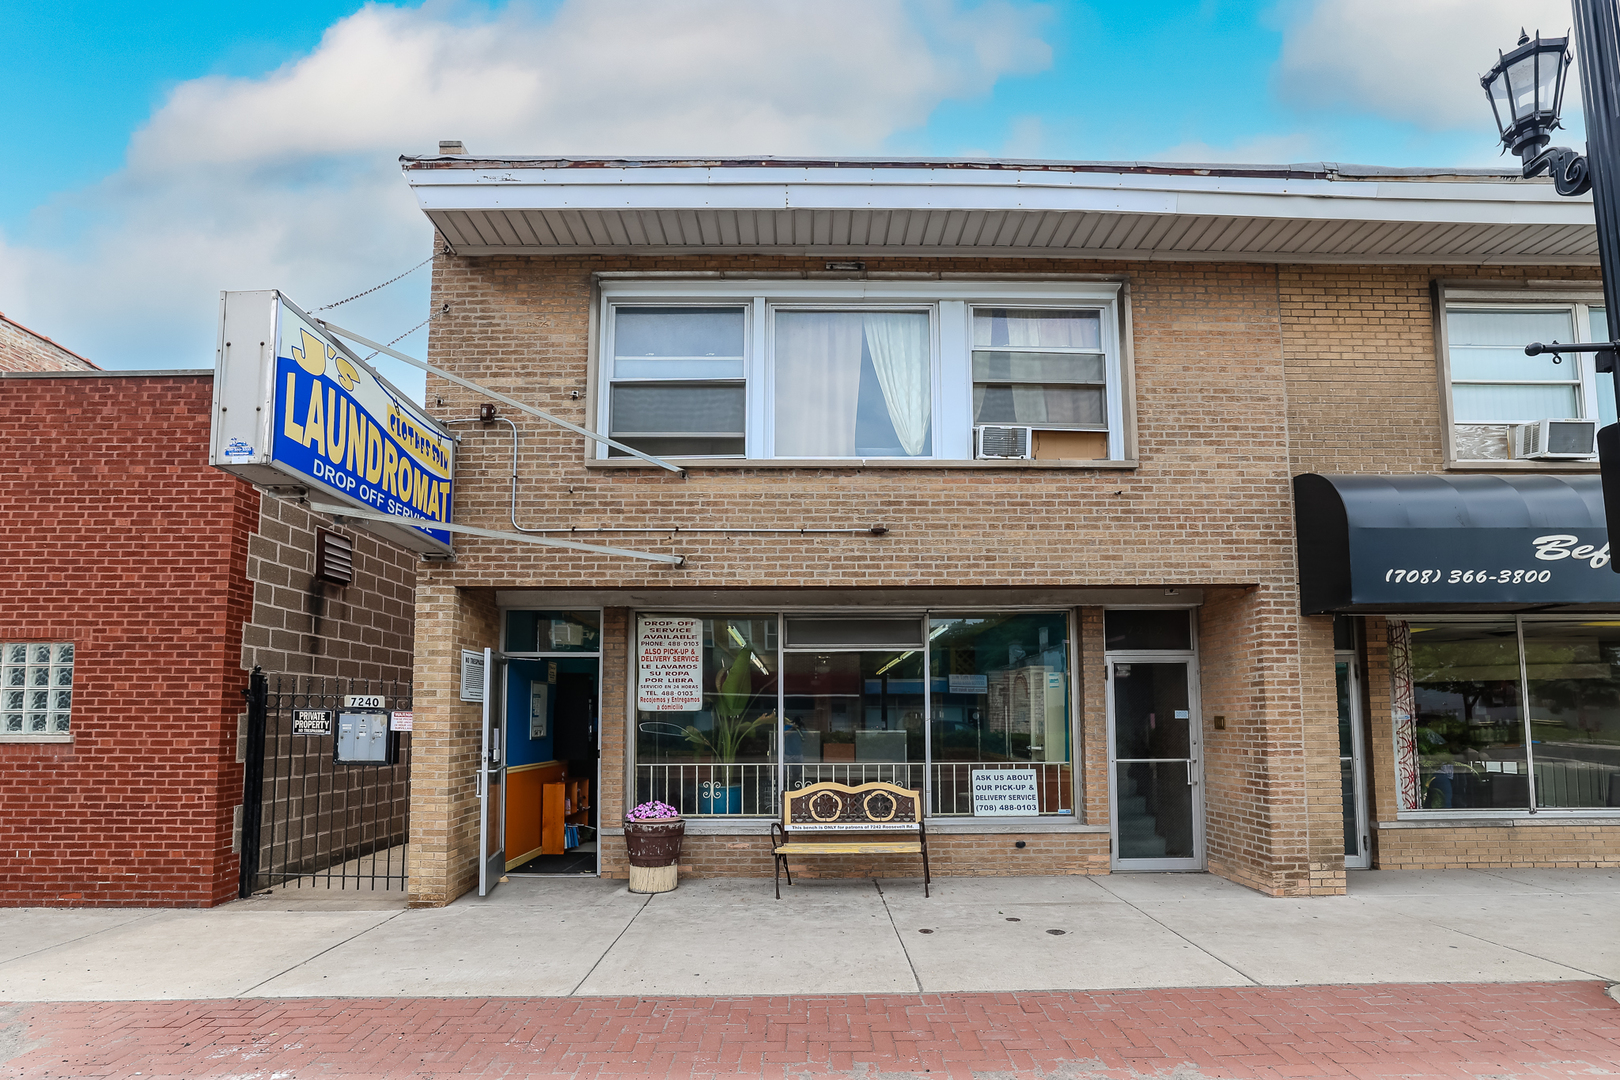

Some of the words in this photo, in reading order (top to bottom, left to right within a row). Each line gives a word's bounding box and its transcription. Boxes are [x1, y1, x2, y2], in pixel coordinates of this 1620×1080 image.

[291, 327, 361, 392] J's
[284, 372, 450, 523] LAUNDROMAT
[390, 414, 430, 457] CLOTHES
[313, 458, 356, 496] DROP
[359, 484, 385, 507] OFF
[1532, 534, 1611, 569] Bef
[1385, 568, 1442, 584] (708)
[1448, 569, 1551, 584] 366-3800
[299, 712, 325, 720] PRIVATE
[350, 698, 379, 707] 7240
[294, 720, 329, 729] PROPERTY
